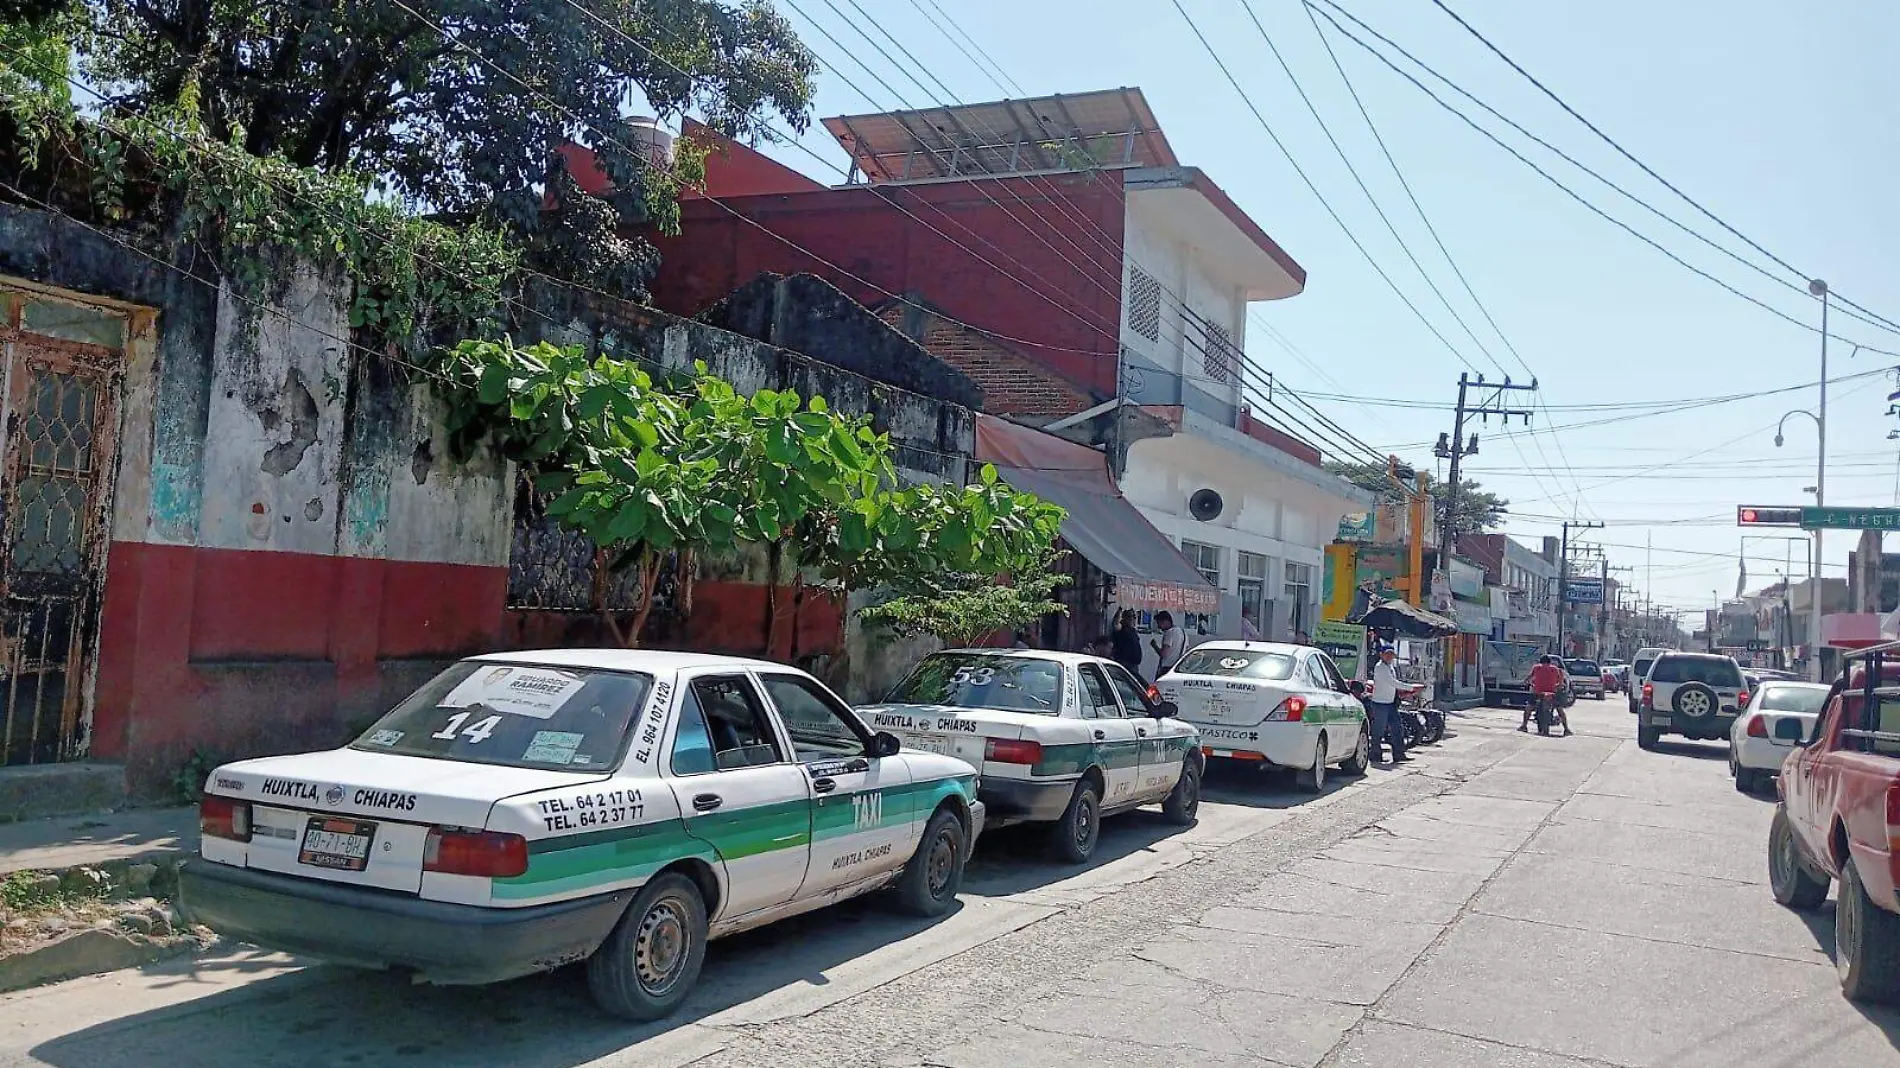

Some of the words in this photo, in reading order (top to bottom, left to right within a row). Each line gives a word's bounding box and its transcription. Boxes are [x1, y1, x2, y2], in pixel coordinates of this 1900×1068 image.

[949, 666, 995, 686] 53
[431, 711, 503, 744] 14
[642, 723, 656, 746] 964
[650, 704, 663, 723] 107
[658, 681, 671, 705] 4120
[874, 713, 917, 730] HUIXTLA,
[937, 717, 977, 733] CHIAPAS
[261, 779, 320, 804] HUIXTLA,
[354, 789, 417, 811] CHIAPAS
[538, 798, 574, 813] TEL.
[576, 794, 593, 809] 64
[596, 793, 606, 807] 2
[609, 791, 622, 806] 17
[627, 789, 642, 802] 01
[544, 815, 577, 831] TEL.
[580, 812, 597, 827] 64
[599, 810, 609, 824] 2
[612, 808, 625, 822] 37
[629, 805, 644, 819] 77
[852, 792, 882, 830] TAXI
